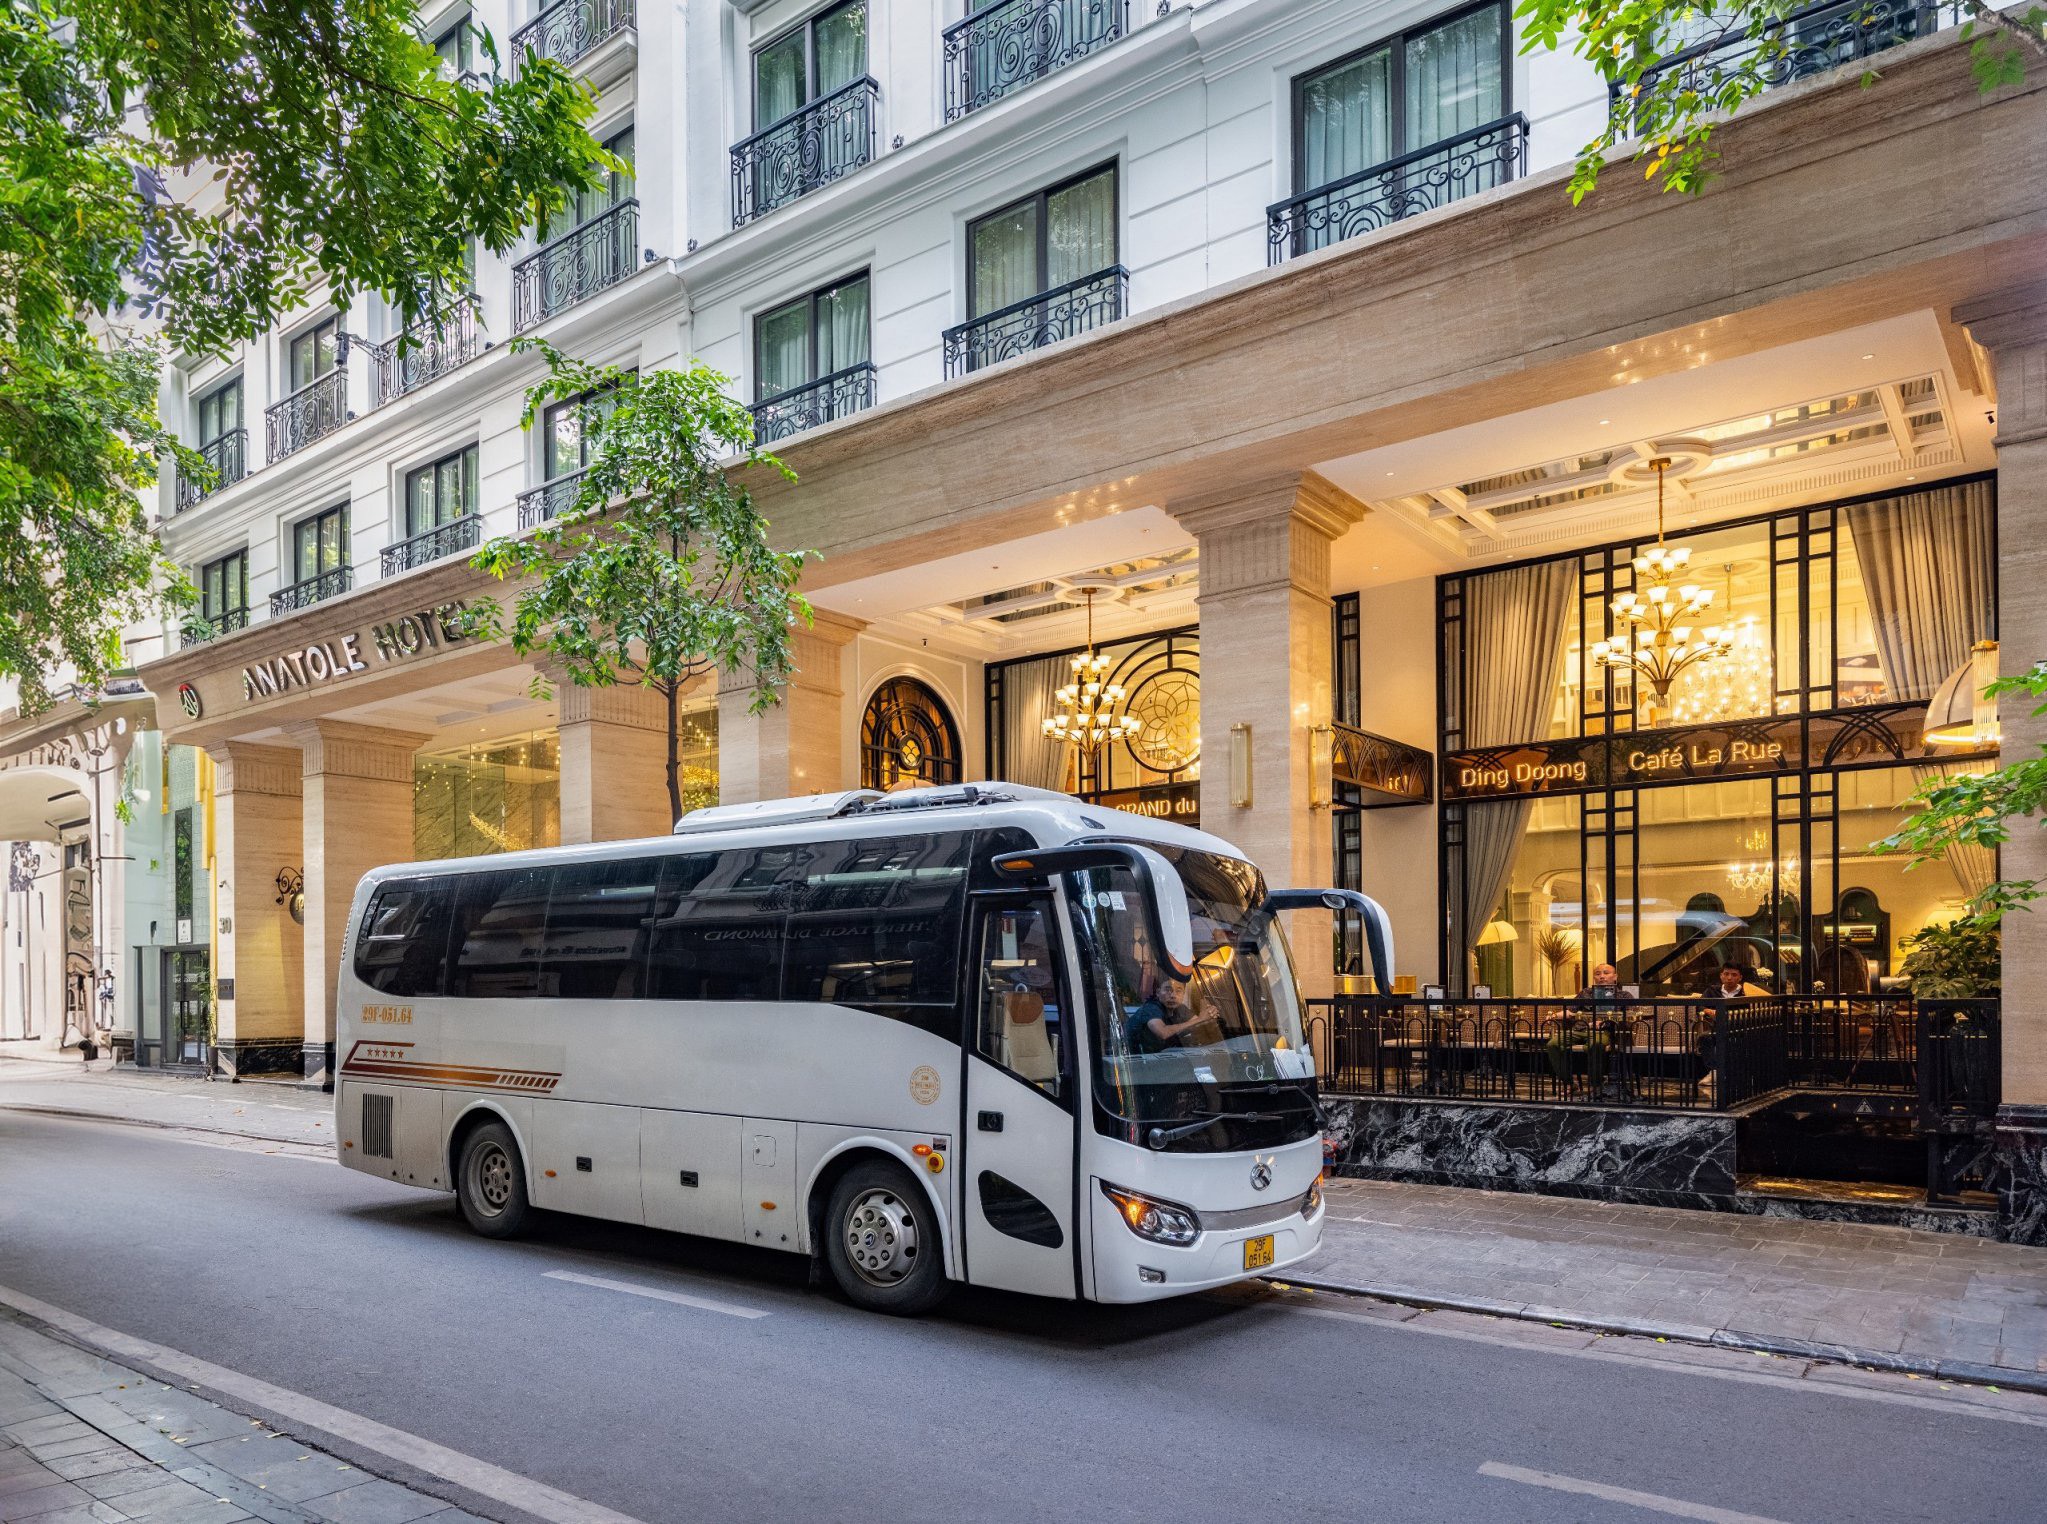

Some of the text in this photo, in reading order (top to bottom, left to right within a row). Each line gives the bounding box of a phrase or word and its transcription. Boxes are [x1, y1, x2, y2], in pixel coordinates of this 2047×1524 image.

[242, 633, 366, 700] ANATOLE
[1629, 740, 1783, 771] Café La Rue
[1461, 761, 1587, 788] Ding Doong
[1176, 797, 1197, 814] du
